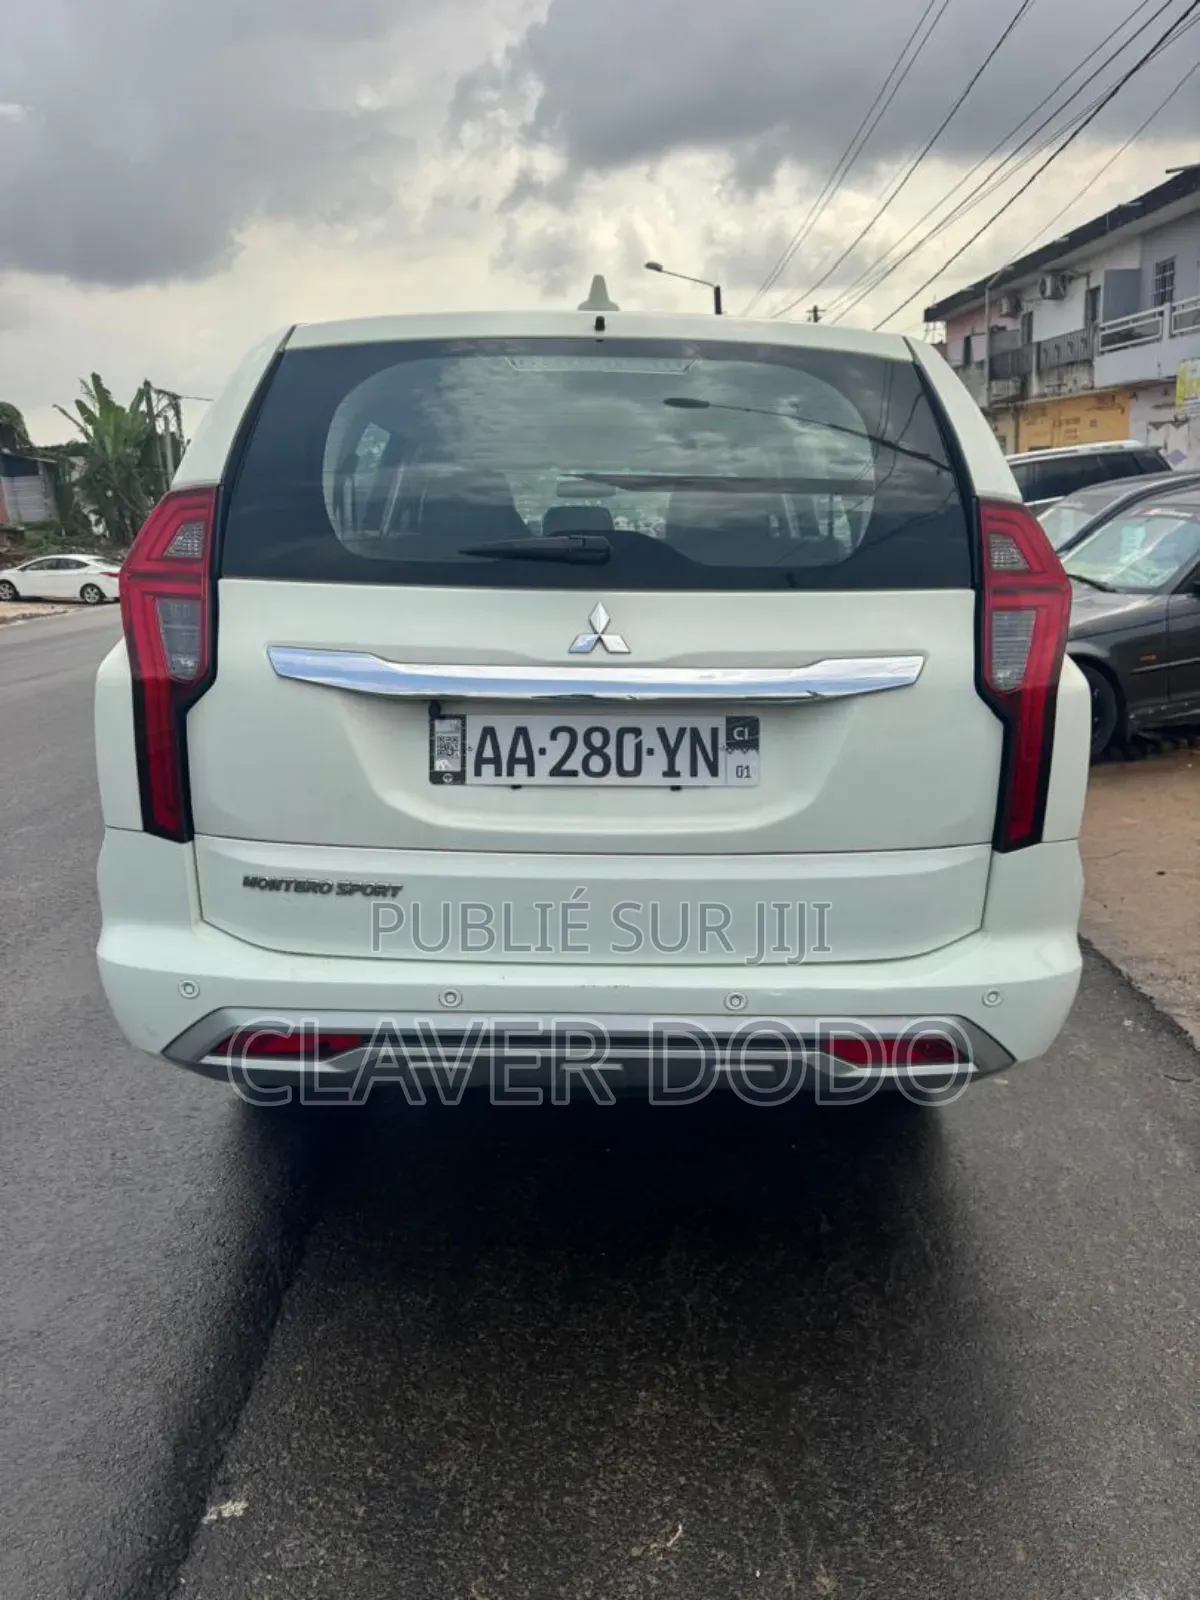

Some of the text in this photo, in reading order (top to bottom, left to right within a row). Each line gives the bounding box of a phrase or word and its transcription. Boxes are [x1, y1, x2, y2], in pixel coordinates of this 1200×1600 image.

[733, 726, 749, 741] CI
[736, 764, 752, 779] 01
[242, 875, 404, 898] MONTERO SPORT
